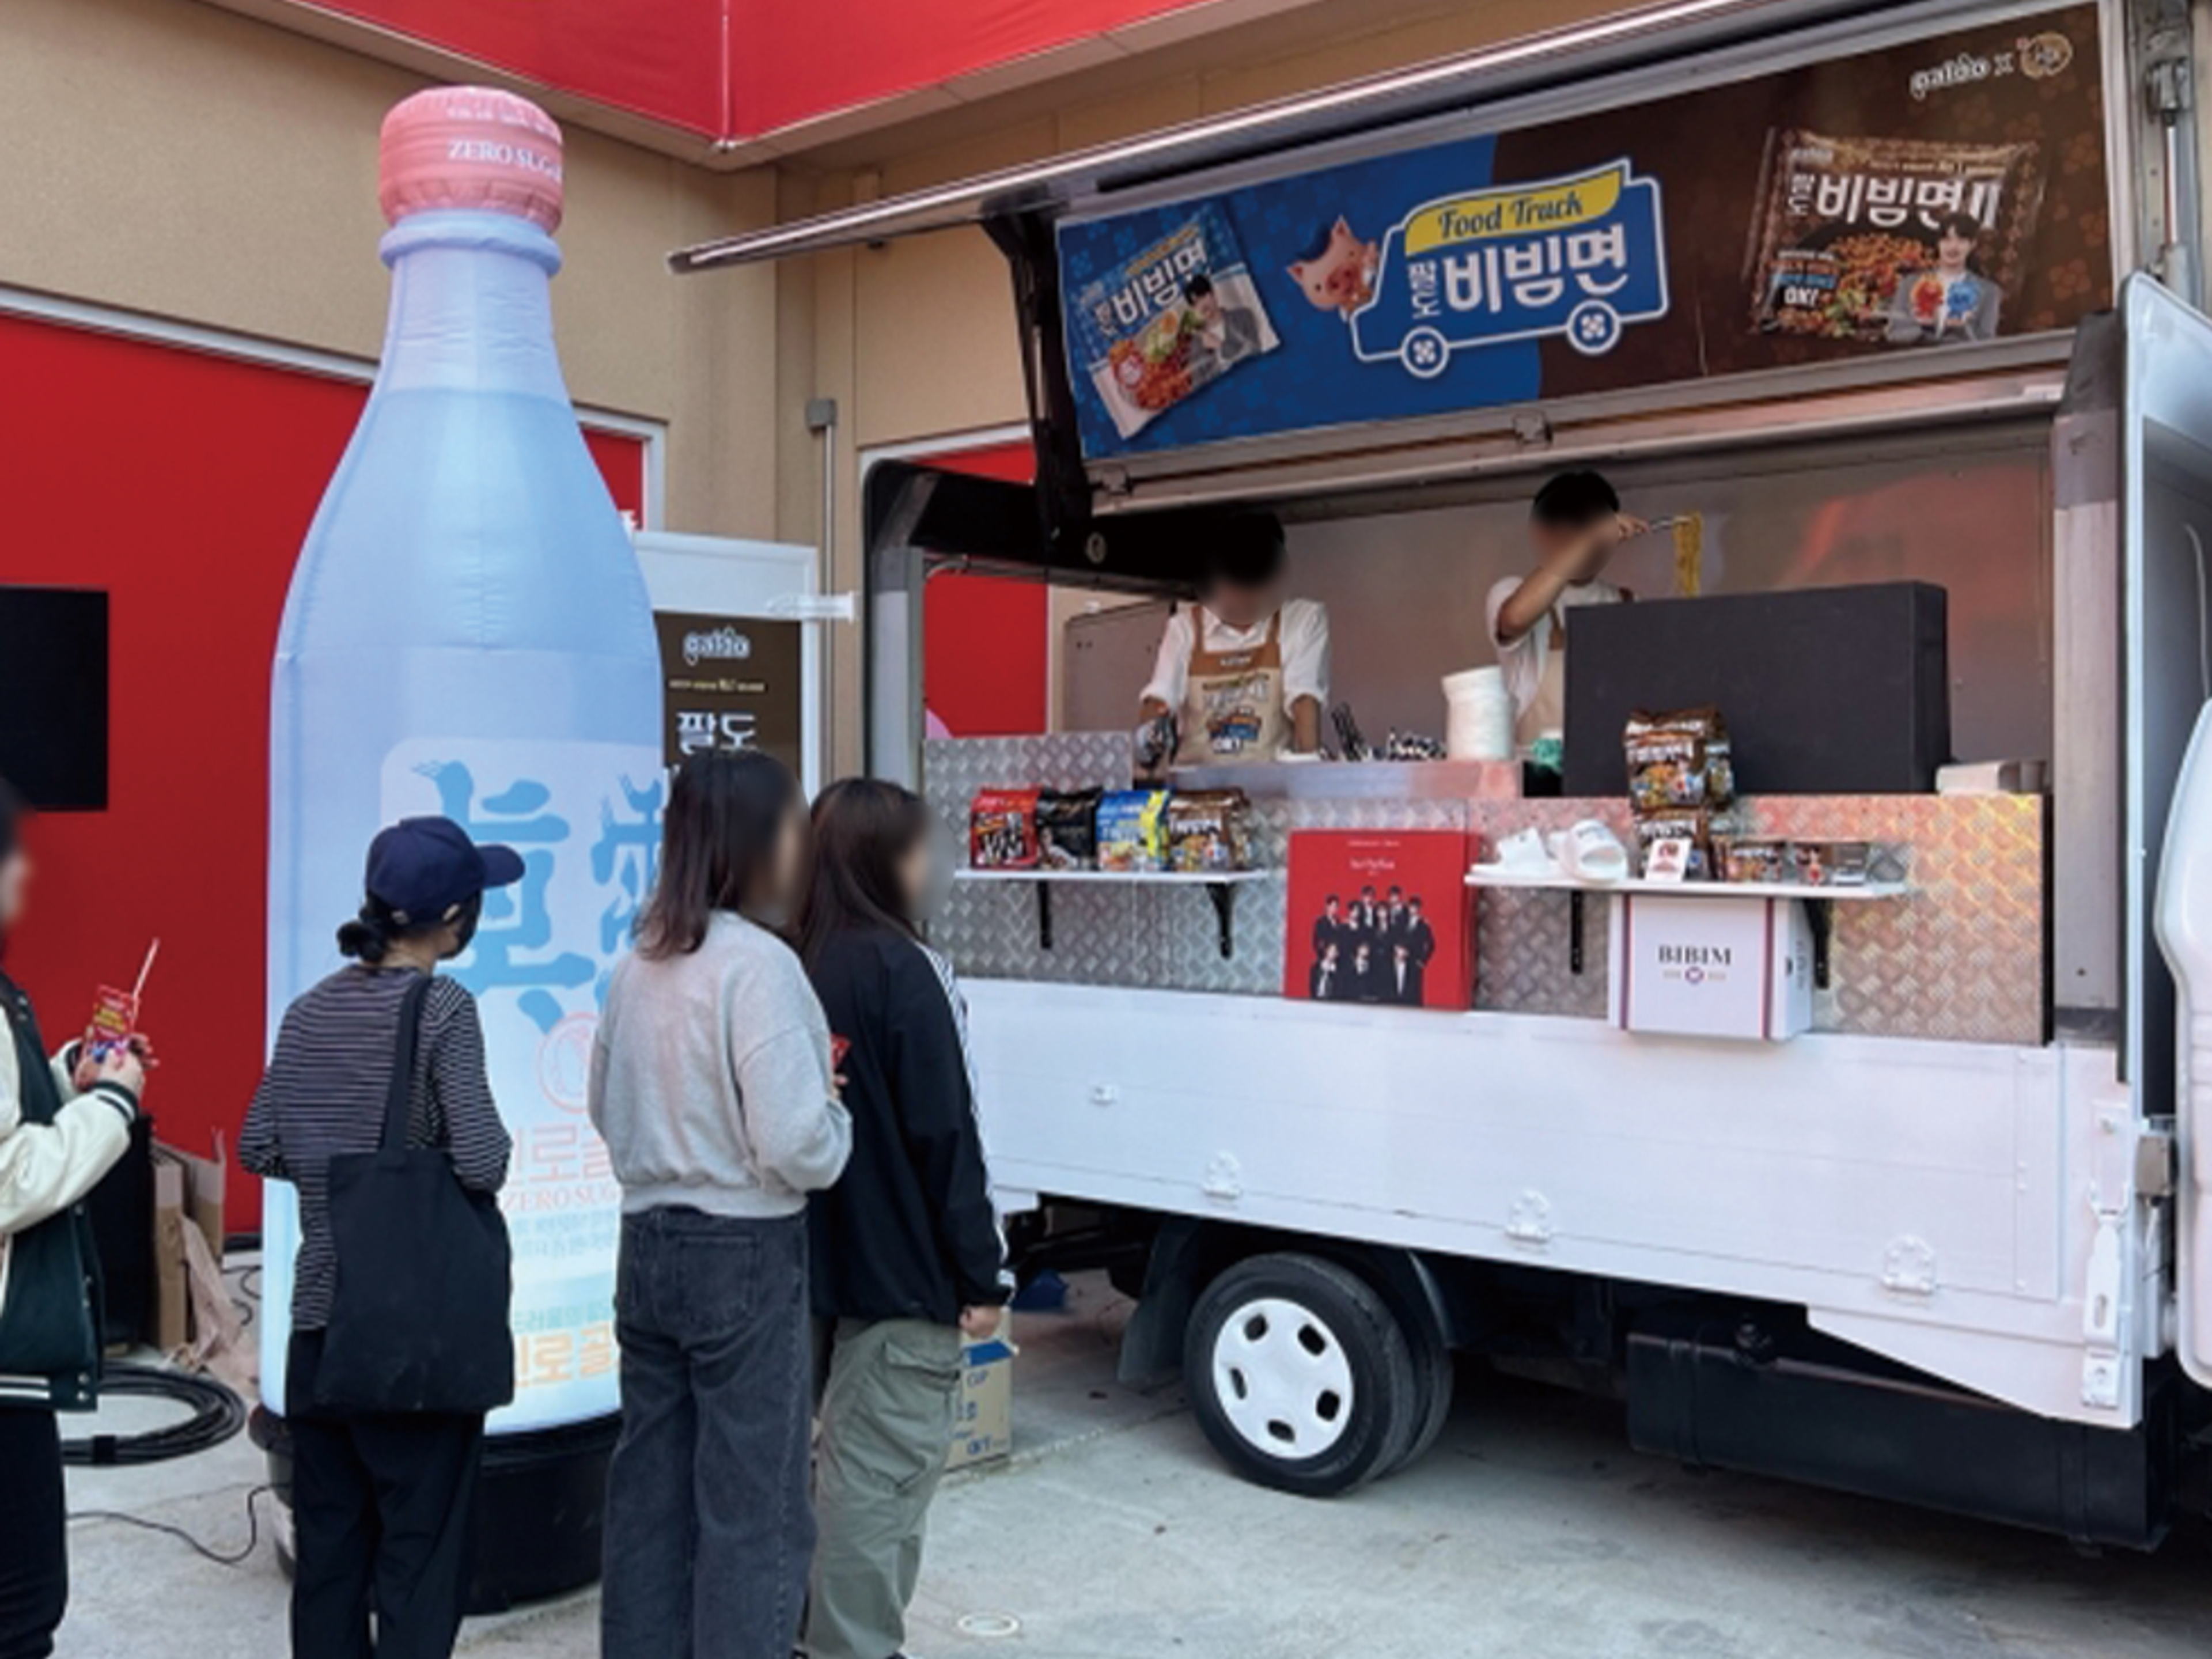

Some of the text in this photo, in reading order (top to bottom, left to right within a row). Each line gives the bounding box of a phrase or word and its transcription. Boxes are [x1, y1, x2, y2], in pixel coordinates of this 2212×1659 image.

[448, 139, 512, 165] ZERO
[1438, 190, 1584, 239] Food Truck
[1111, 237, 1209, 325] 비빔면
[1442, 222, 1629, 313] 비빔면
[676, 711, 757, 755] 팔도
[1658, 945, 1732, 966] BIBIM
